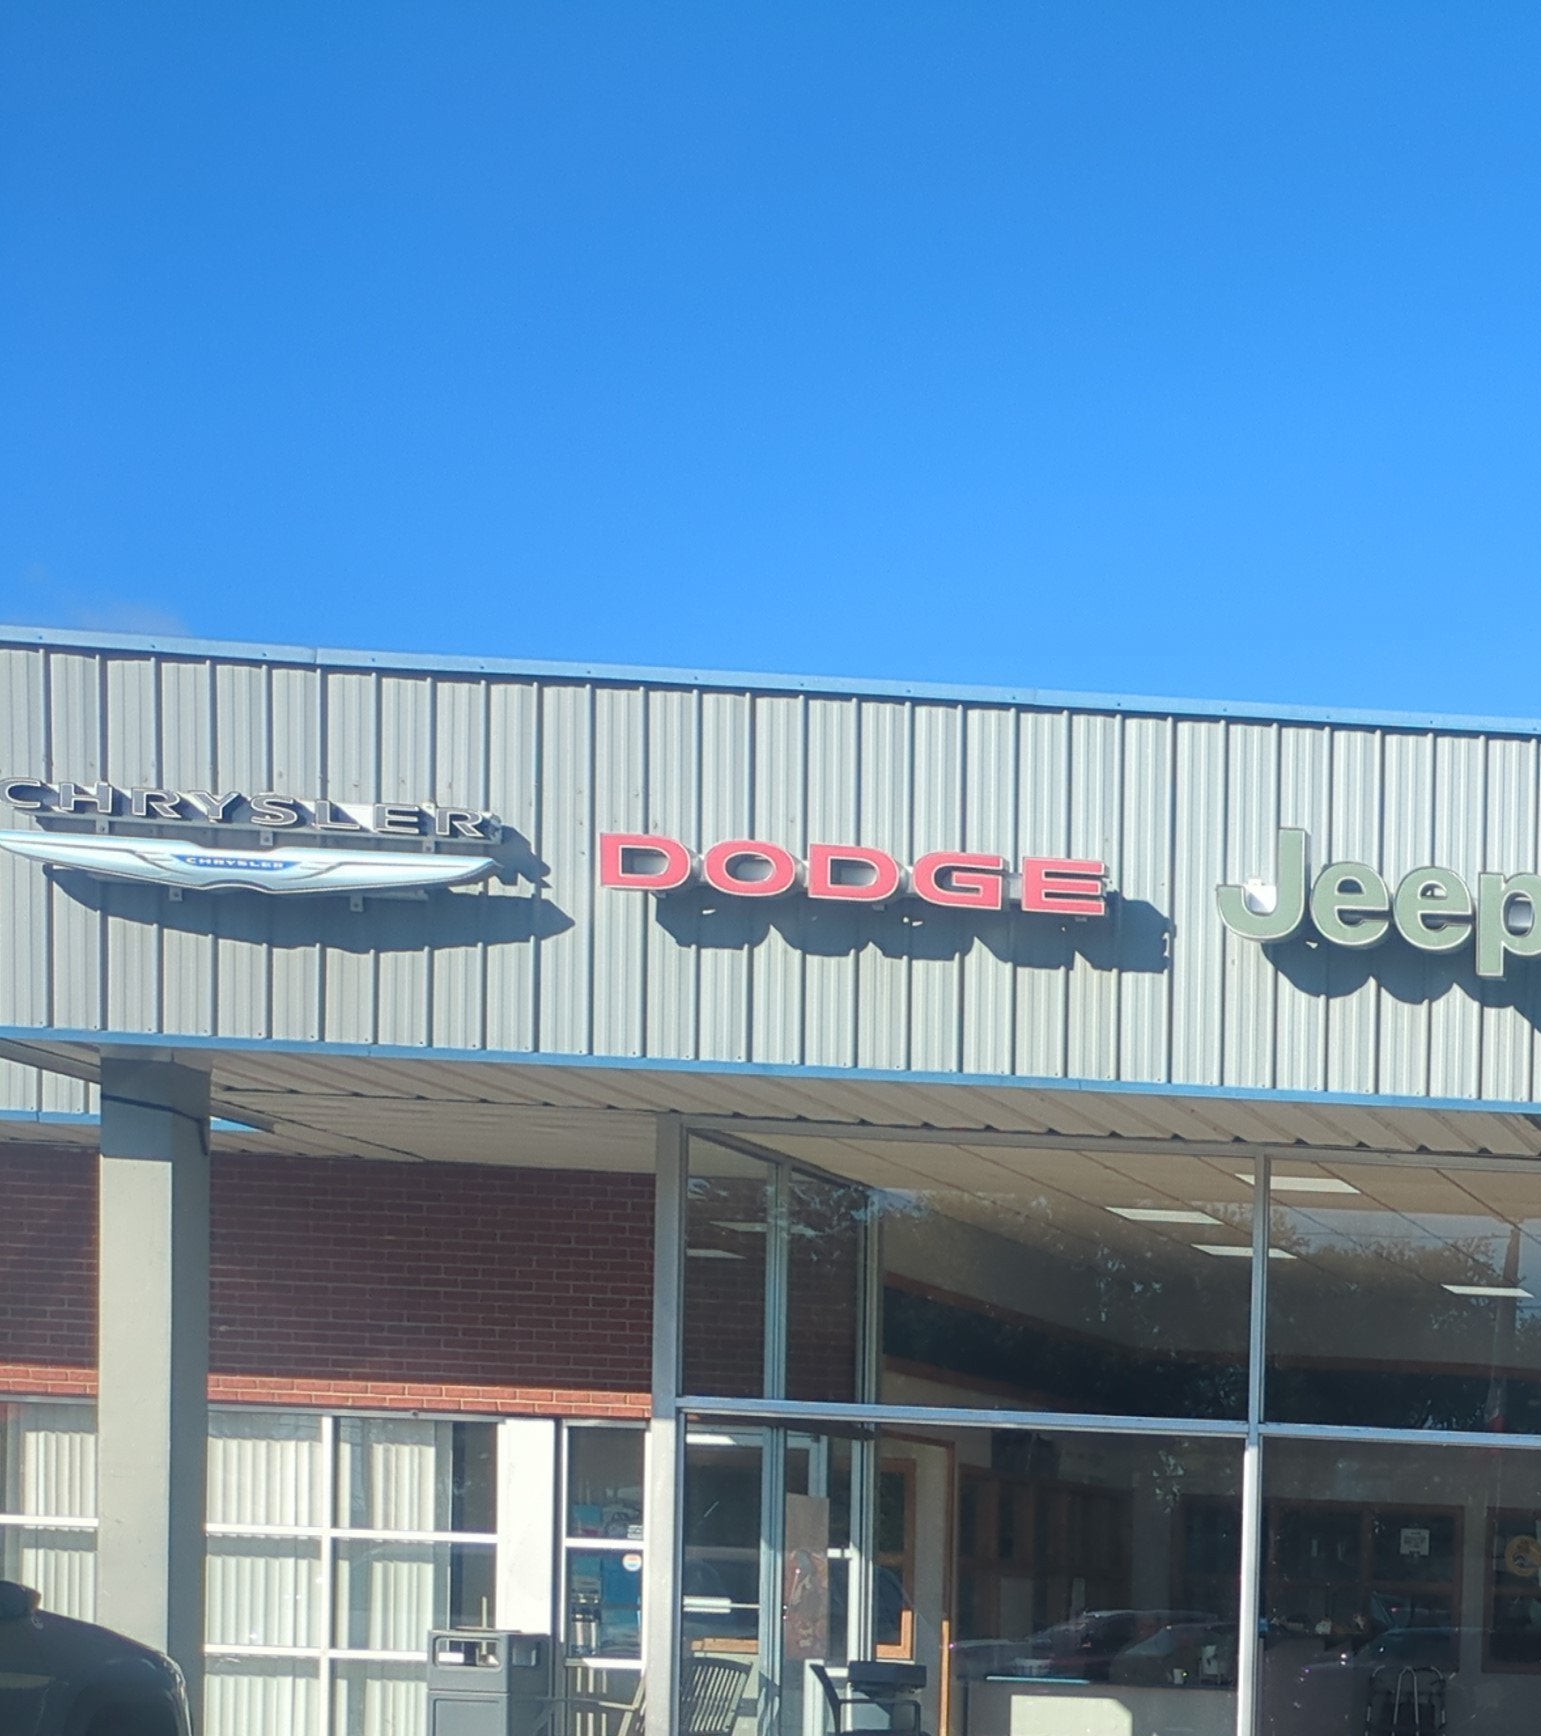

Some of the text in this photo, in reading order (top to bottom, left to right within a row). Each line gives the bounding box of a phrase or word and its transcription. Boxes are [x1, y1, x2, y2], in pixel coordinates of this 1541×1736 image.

[2, 779, 487, 838] CHRYSLER
[185, 856, 284, 869] CHRYSLER
[600, 832, 1106, 916] DODGE
